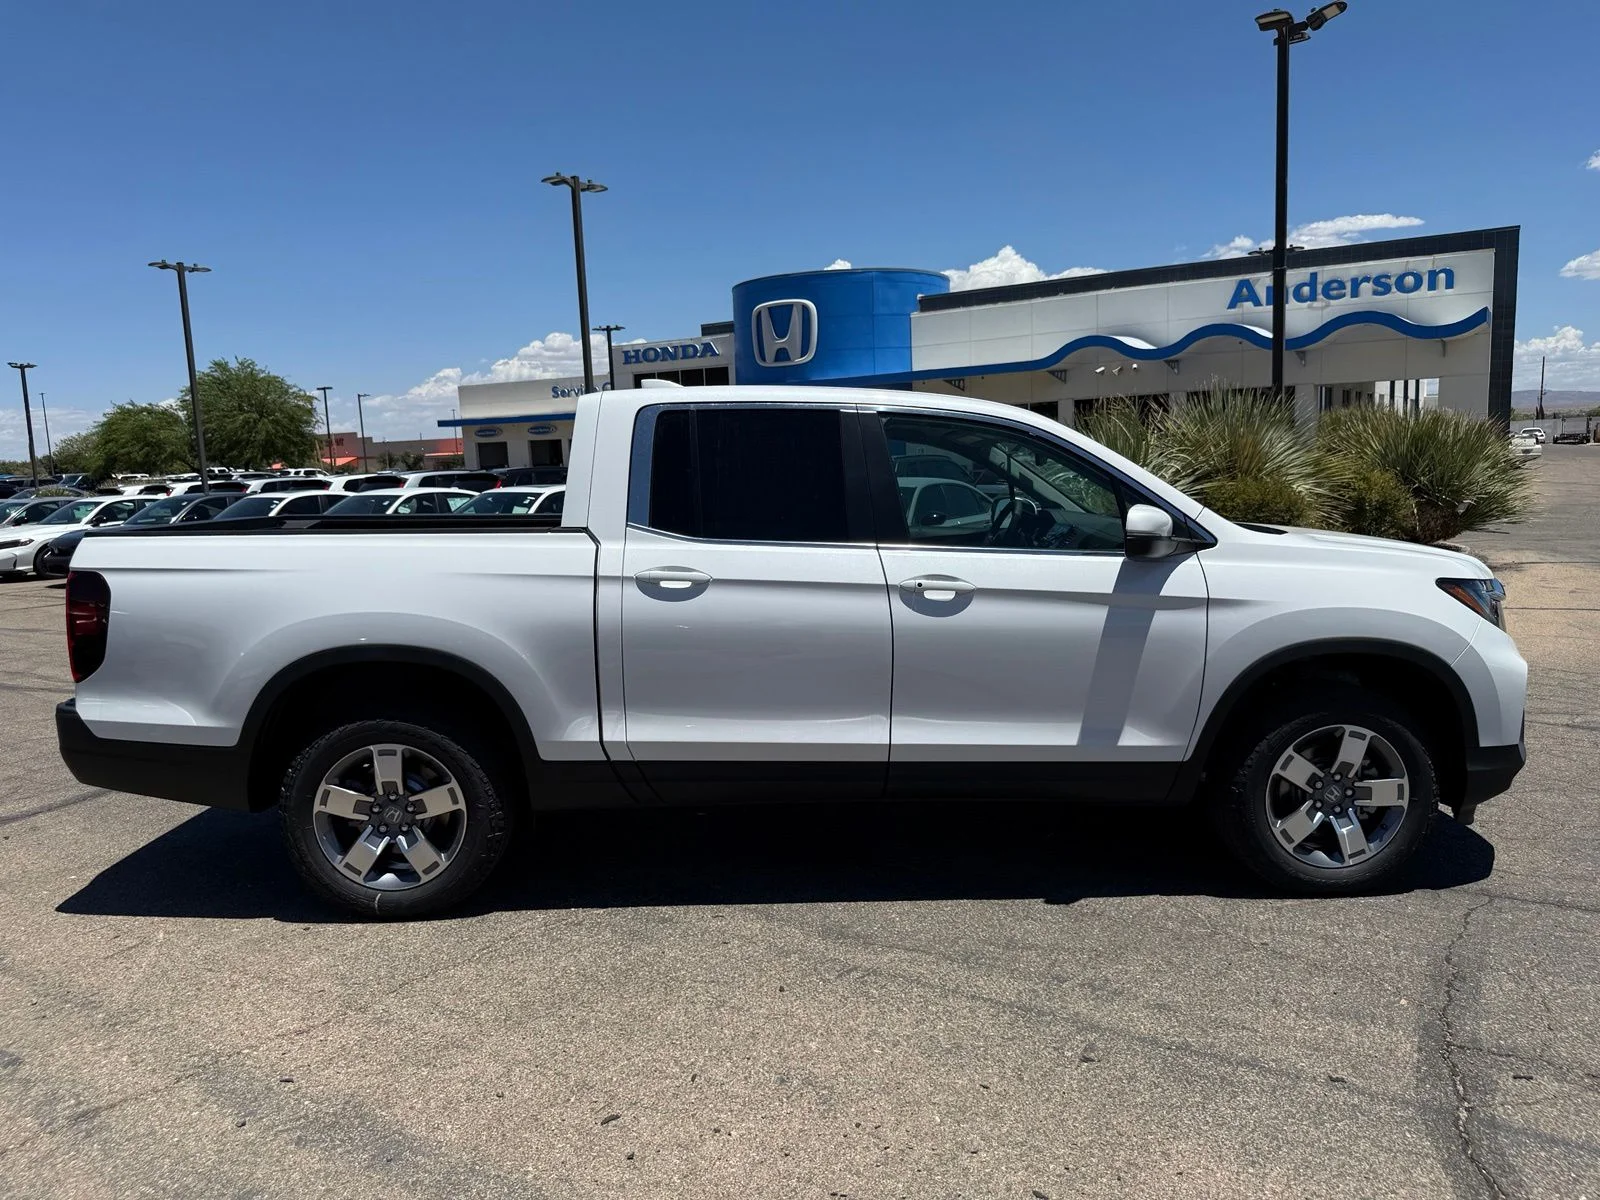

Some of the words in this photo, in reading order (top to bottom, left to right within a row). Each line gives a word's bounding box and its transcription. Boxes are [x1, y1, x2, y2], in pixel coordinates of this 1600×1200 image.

[1227, 266, 1455, 309] Anderson
[622, 341, 719, 365] HONDA
[551, 383, 600, 399] Servi
